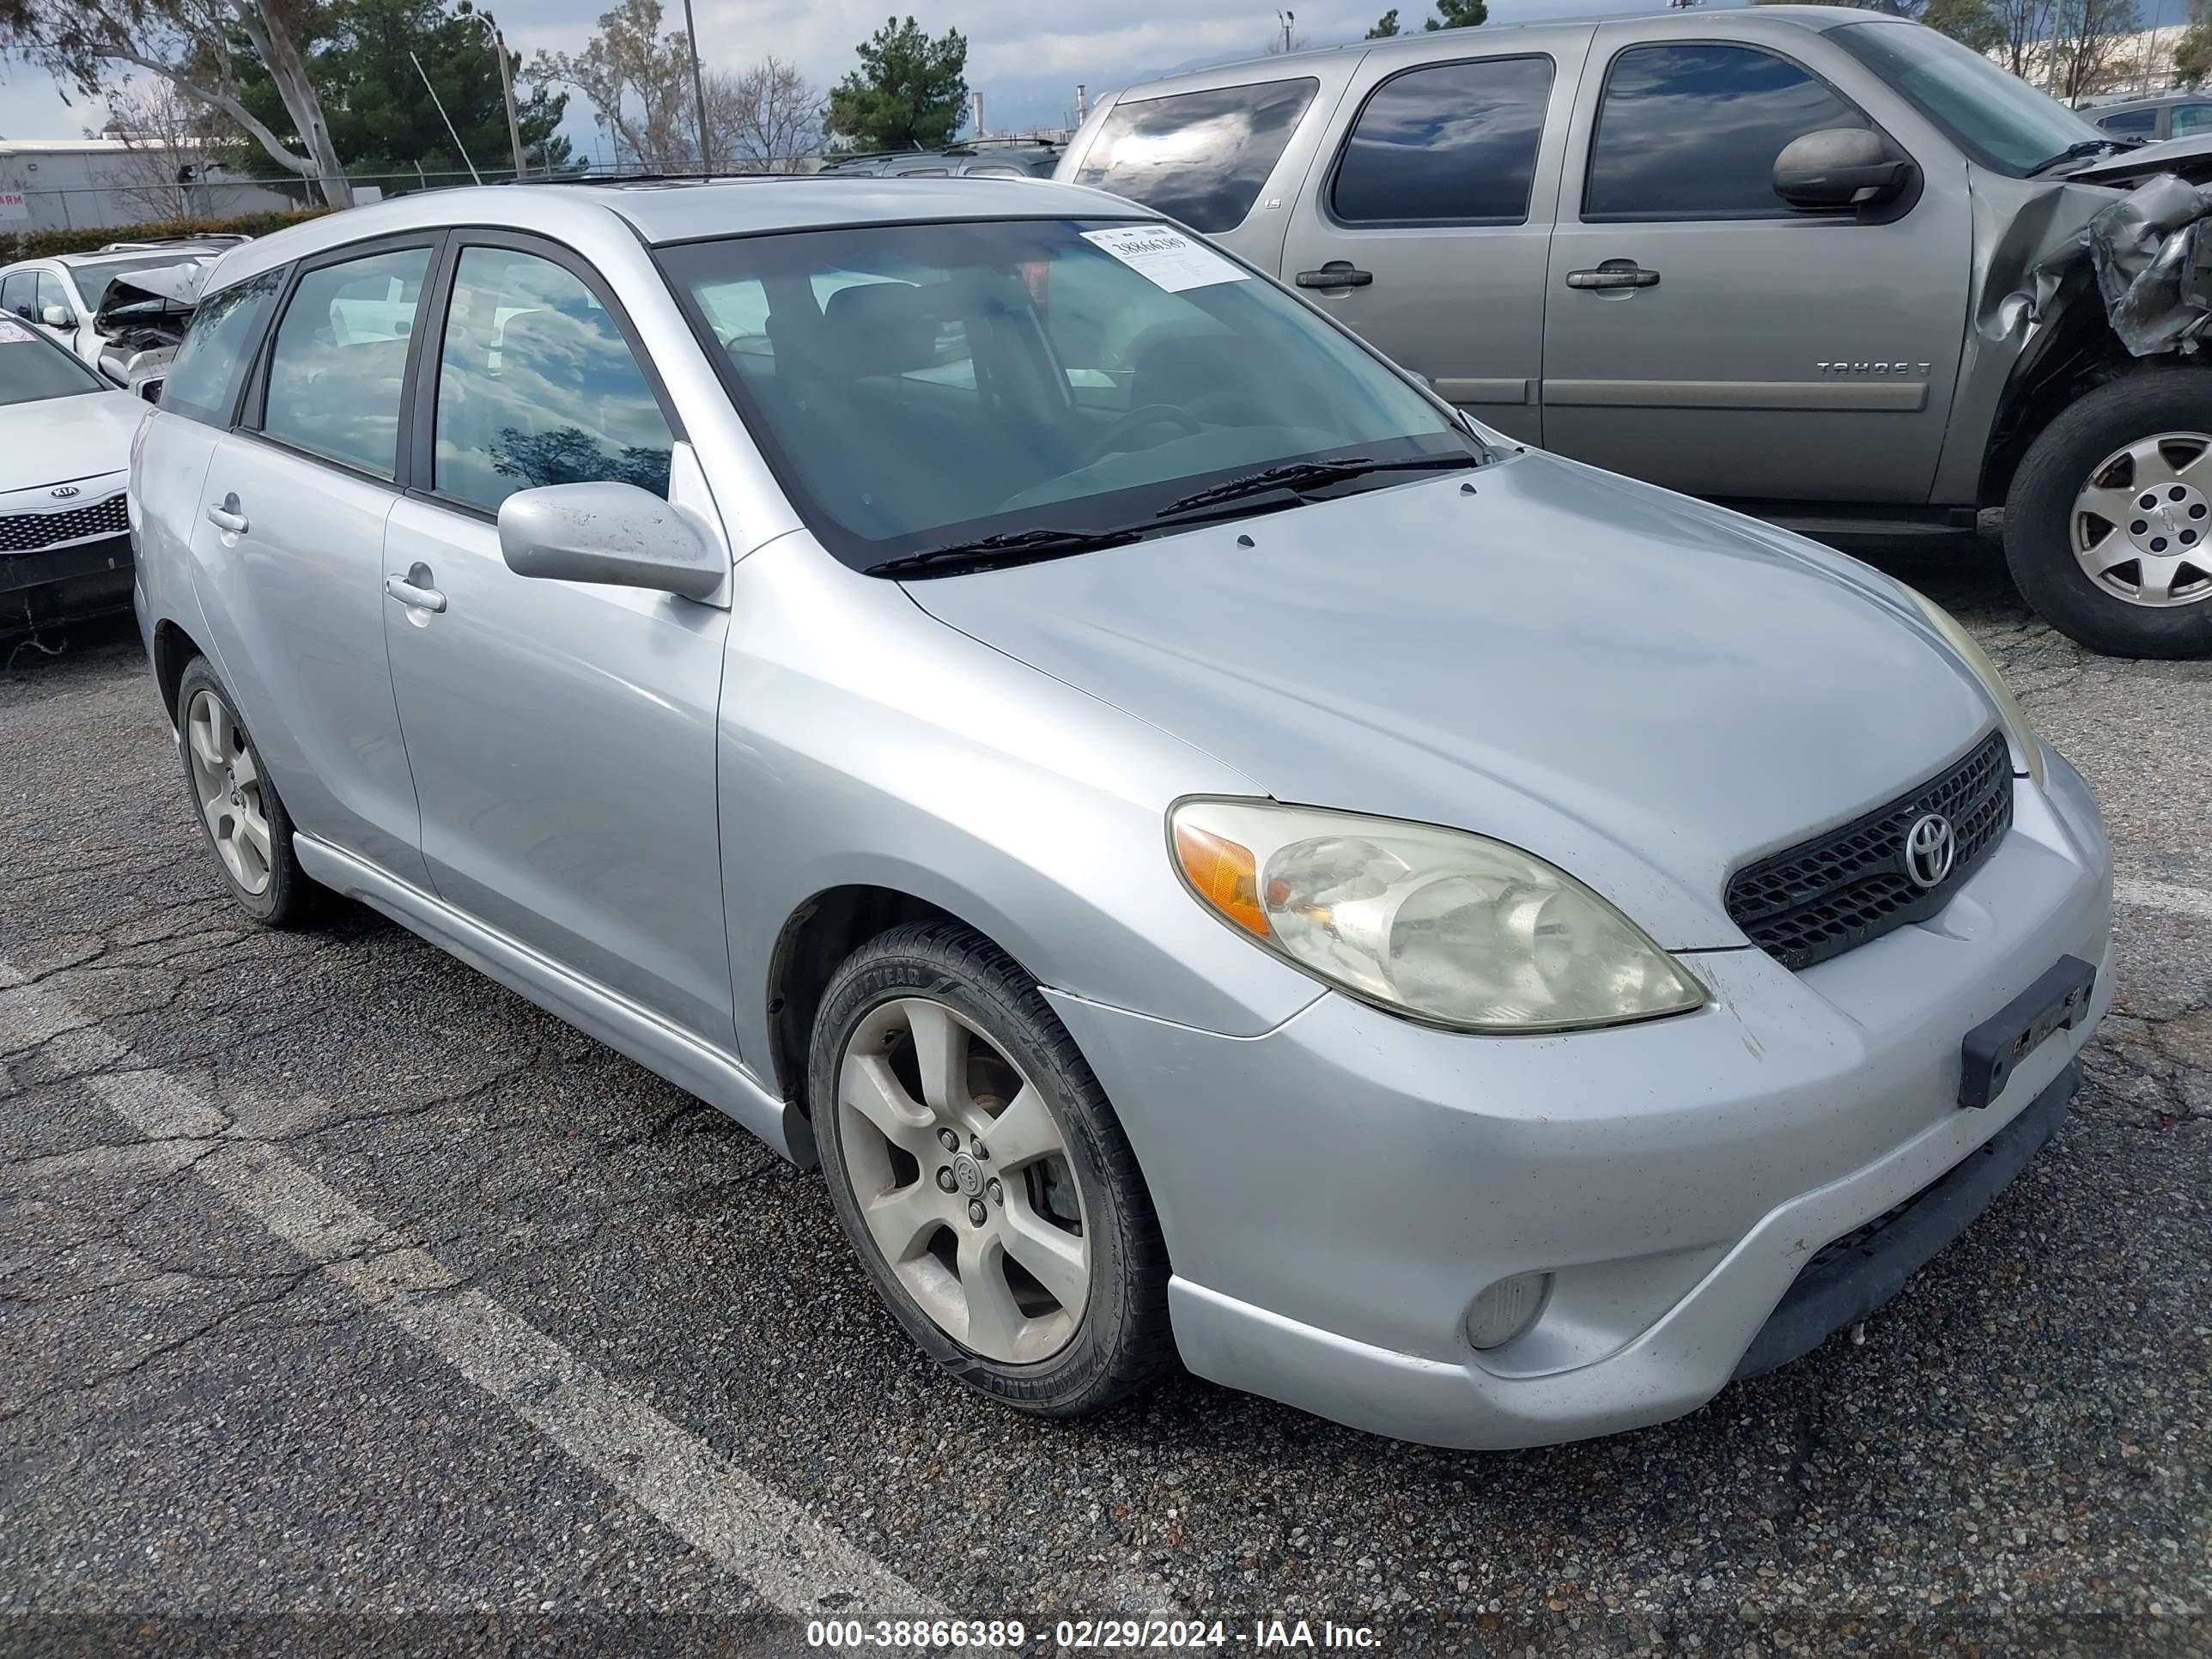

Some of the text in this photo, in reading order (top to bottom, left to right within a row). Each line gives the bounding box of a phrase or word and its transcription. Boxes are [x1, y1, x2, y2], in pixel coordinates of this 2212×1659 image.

[1112, 237, 1187, 256] 38866389
[1816, 362, 1910, 374] TAHOE
[53, 488, 77, 496] KIA
